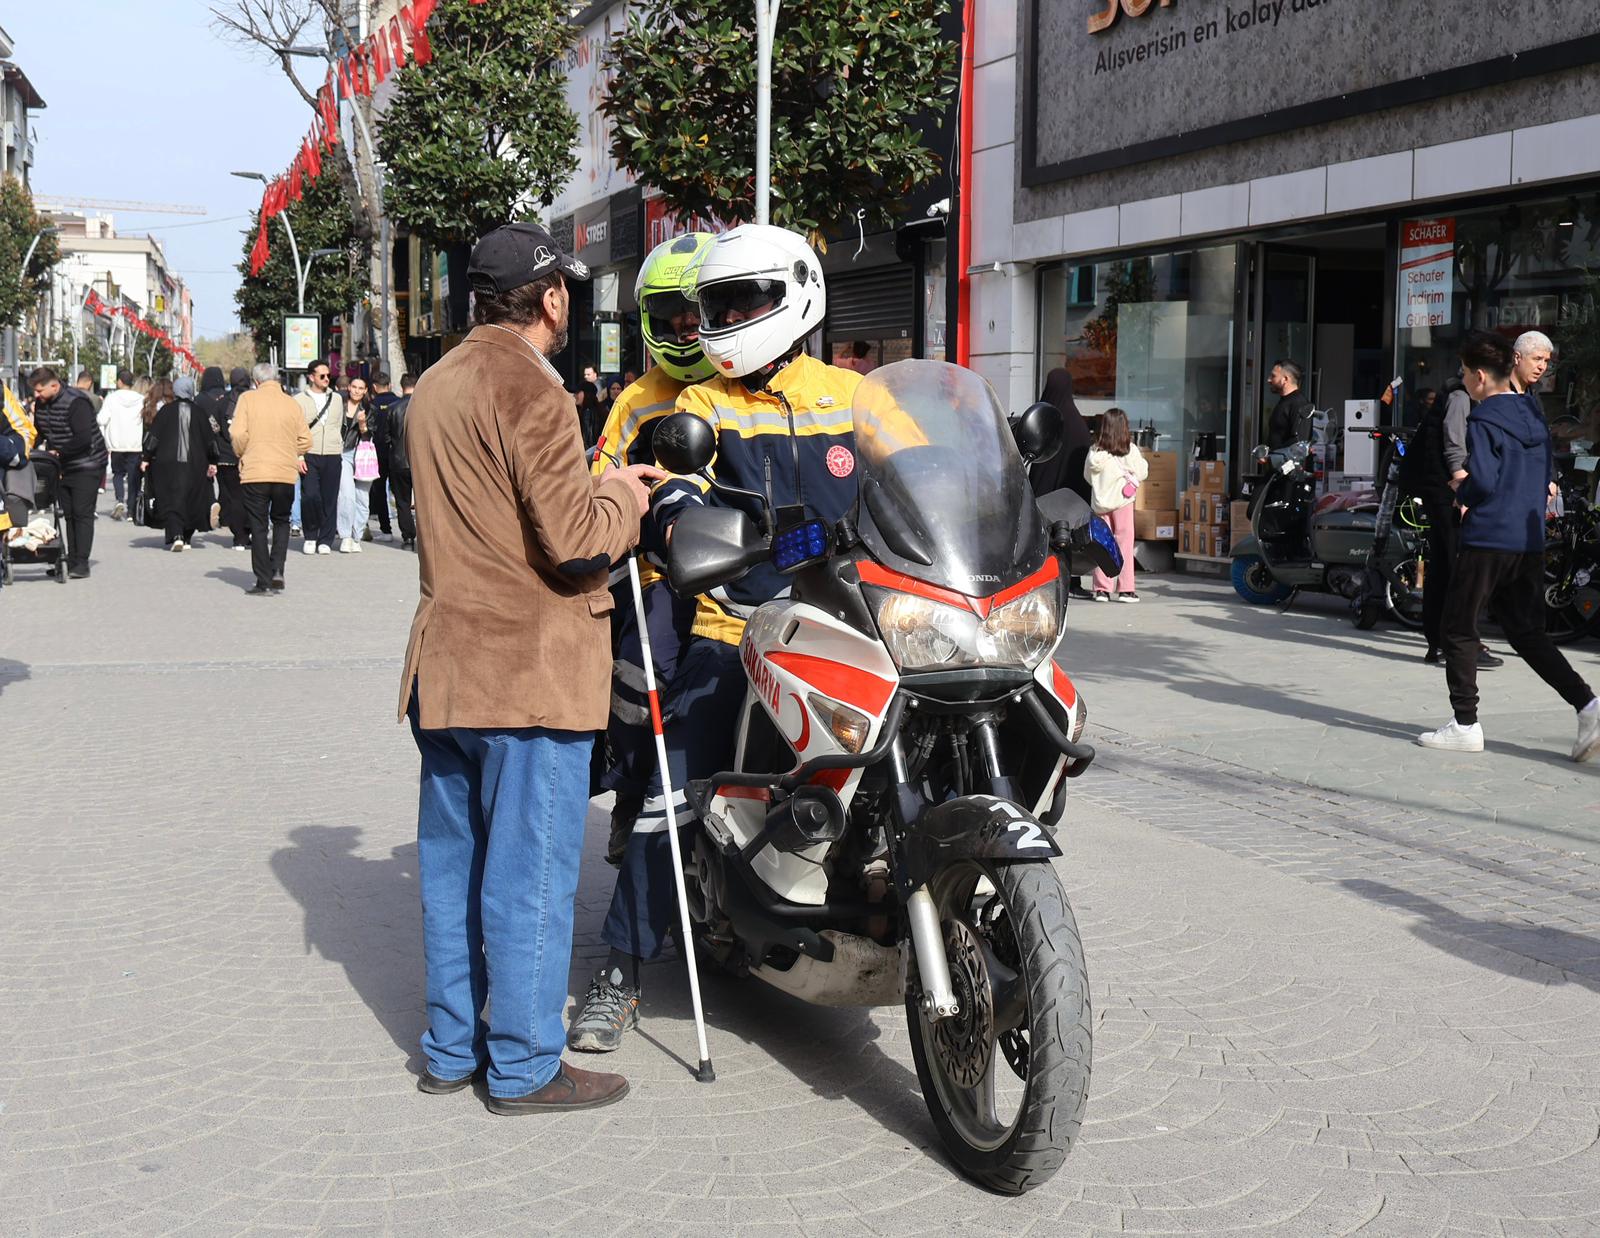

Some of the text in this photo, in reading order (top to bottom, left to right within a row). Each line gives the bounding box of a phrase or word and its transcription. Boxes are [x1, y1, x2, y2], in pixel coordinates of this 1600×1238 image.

[1094, 0, 1285, 75] Alışverişin en kolay
[1408, 270, 1445, 283] Schafer
[1407, 289, 1444, 305] İndirim
[1406, 311, 1444, 327] Günleri
[963, 574, 1001, 583] ONDA
[743, 636, 781, 715] SAKARYA
